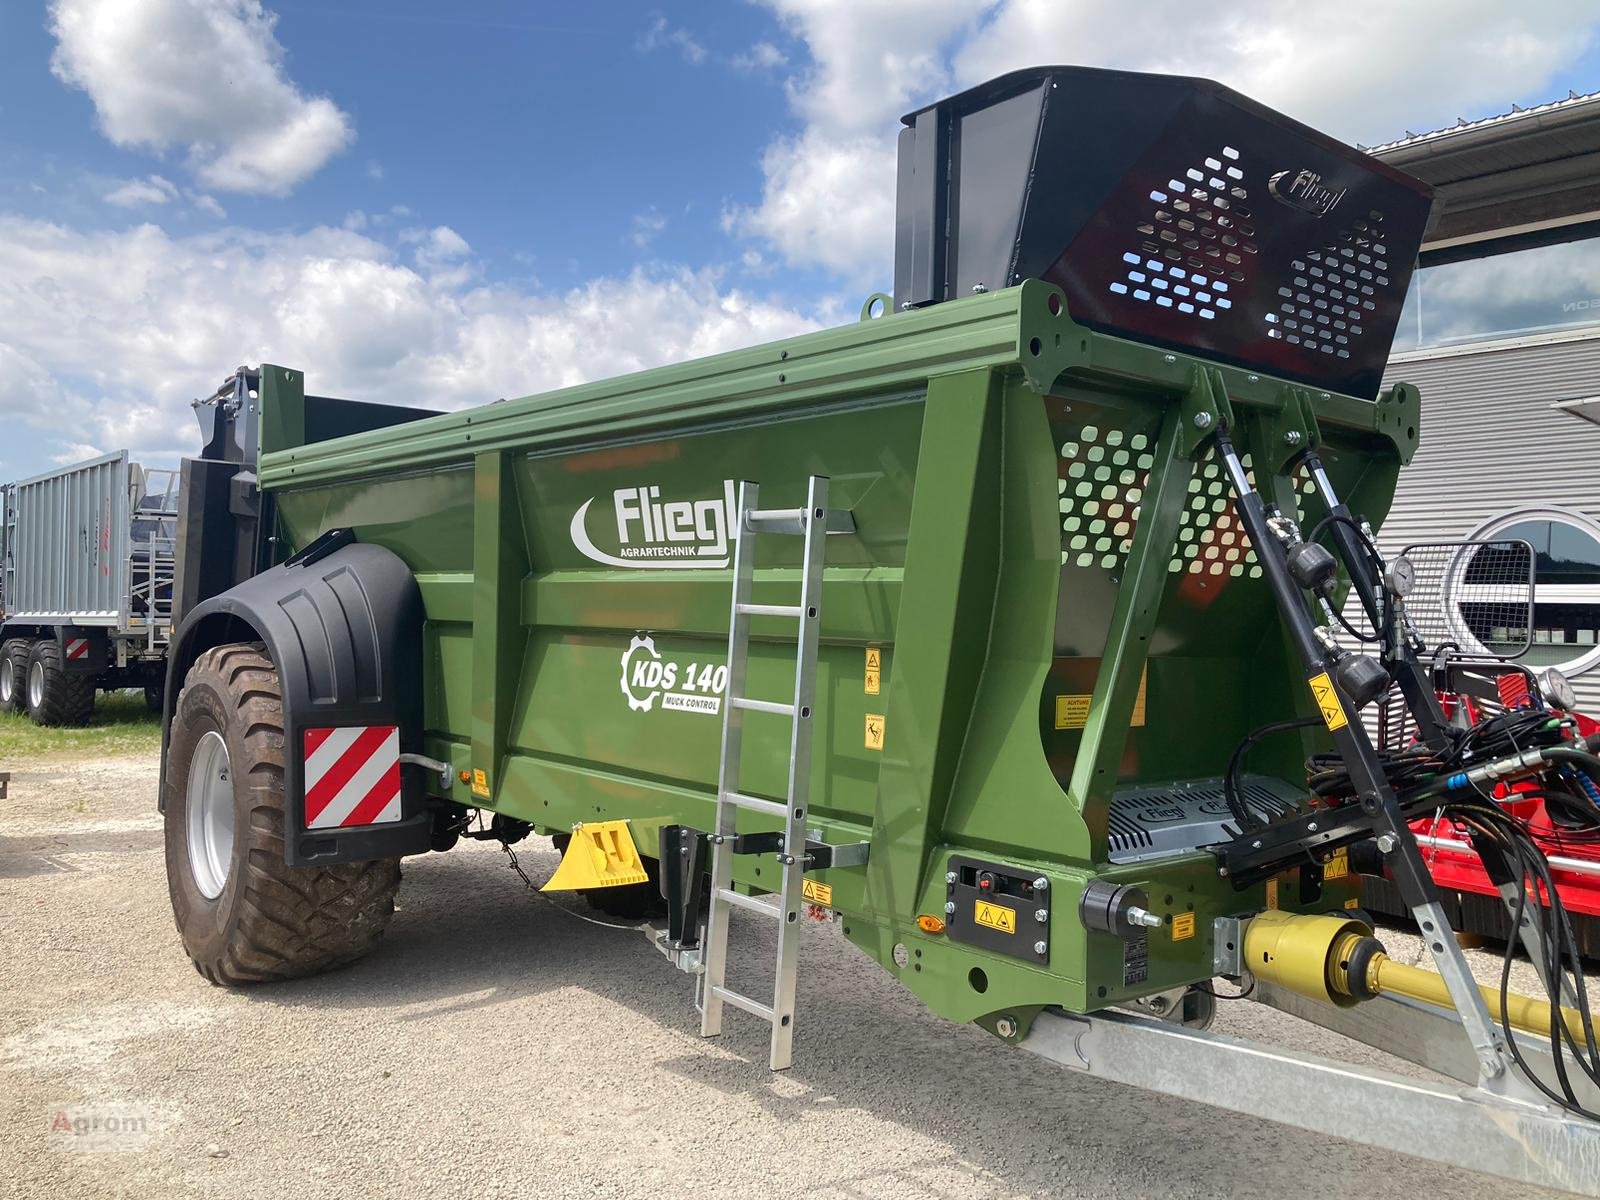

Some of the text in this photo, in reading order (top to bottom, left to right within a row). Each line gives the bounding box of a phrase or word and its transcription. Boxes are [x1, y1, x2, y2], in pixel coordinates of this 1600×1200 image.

[613, 480, 737, 556] Fliegl
[620, 546, 697, 557] AGRARTECHNIK
[631, 660, 728, 694] KDS 140
[665, 696, 718, 711] MUCK CONTROL
[1145, 805, 1186, 819] Fliegl
